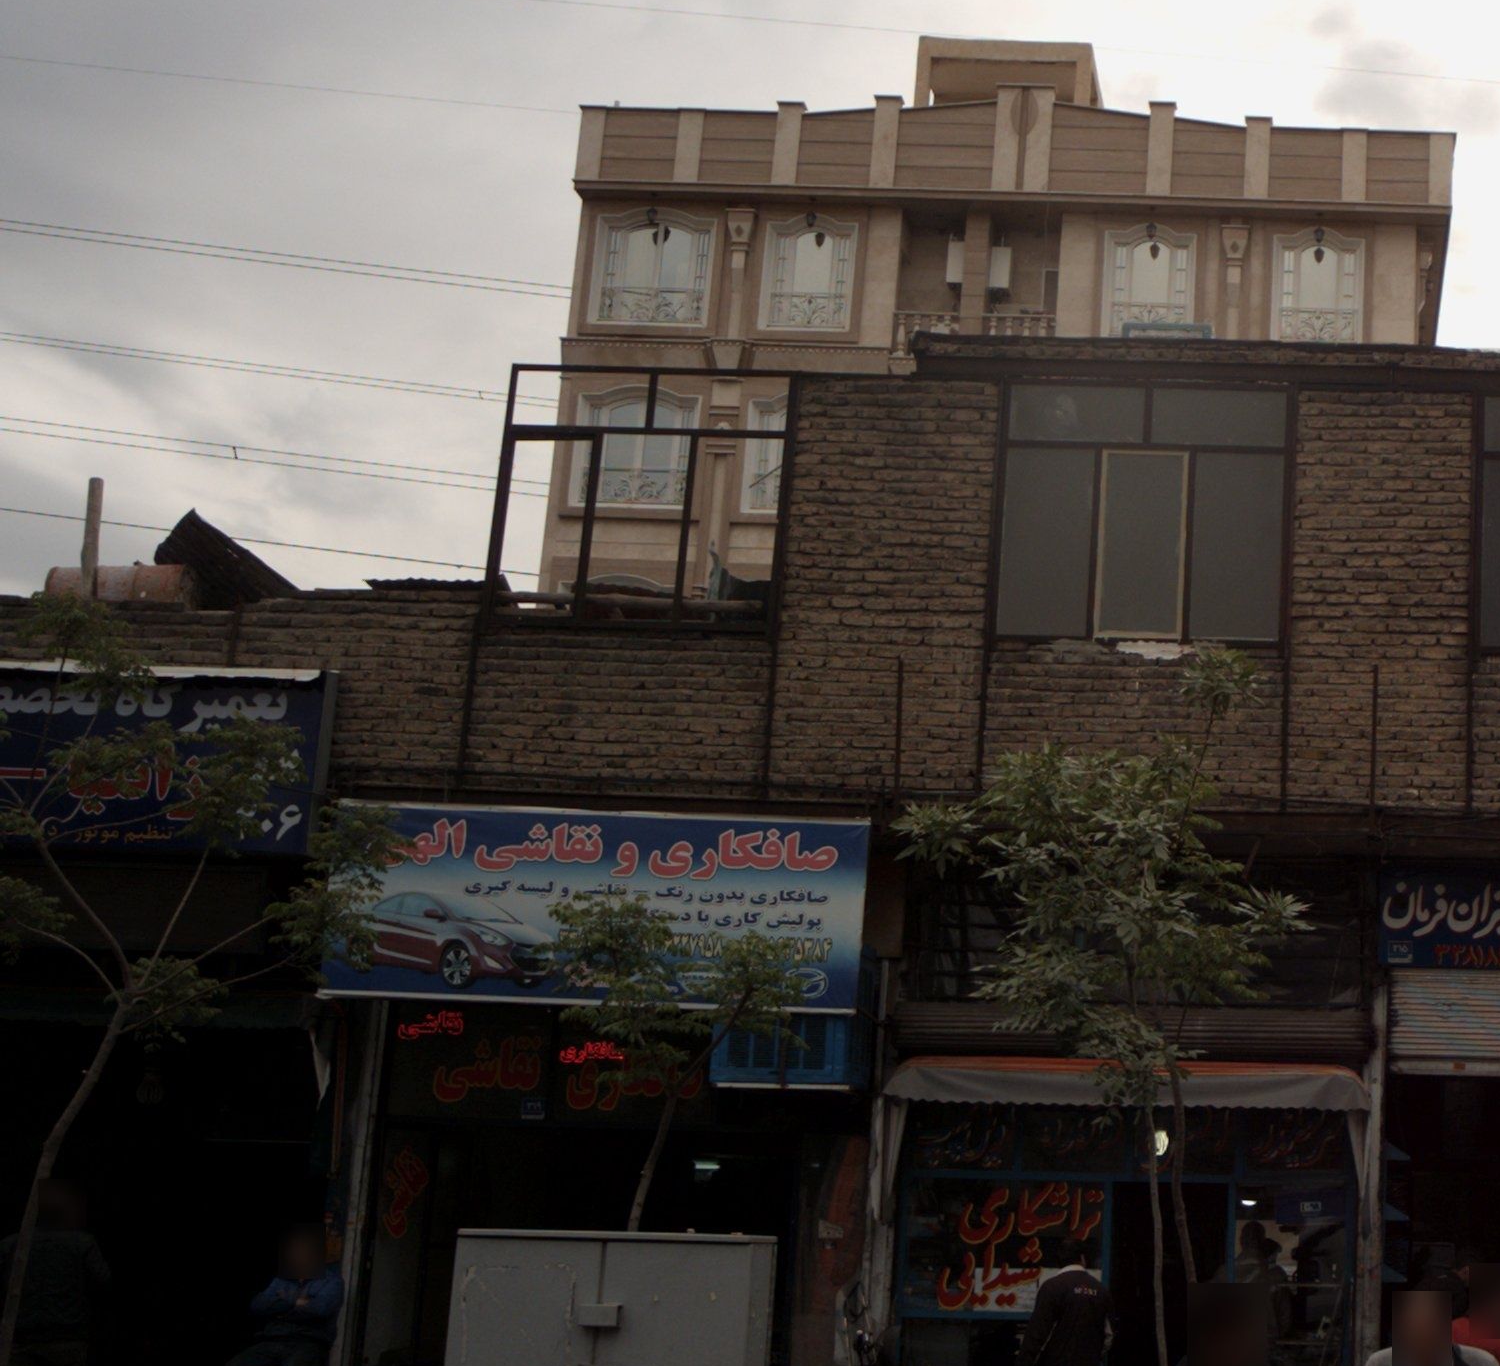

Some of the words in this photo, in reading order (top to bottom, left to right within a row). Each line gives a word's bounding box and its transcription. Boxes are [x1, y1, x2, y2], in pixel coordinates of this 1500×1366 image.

[473, 822, 604, 873] نقاشی
[610, 839, 639, 878] و
[647, 827, 839, 880] صافکاری
[699, 888, 745, 903] بدون
[749, 887, 828, 905] صافکاری
[1381, 881, 1449, 938] فرمان
[714, 912, 761, 929] کاری
